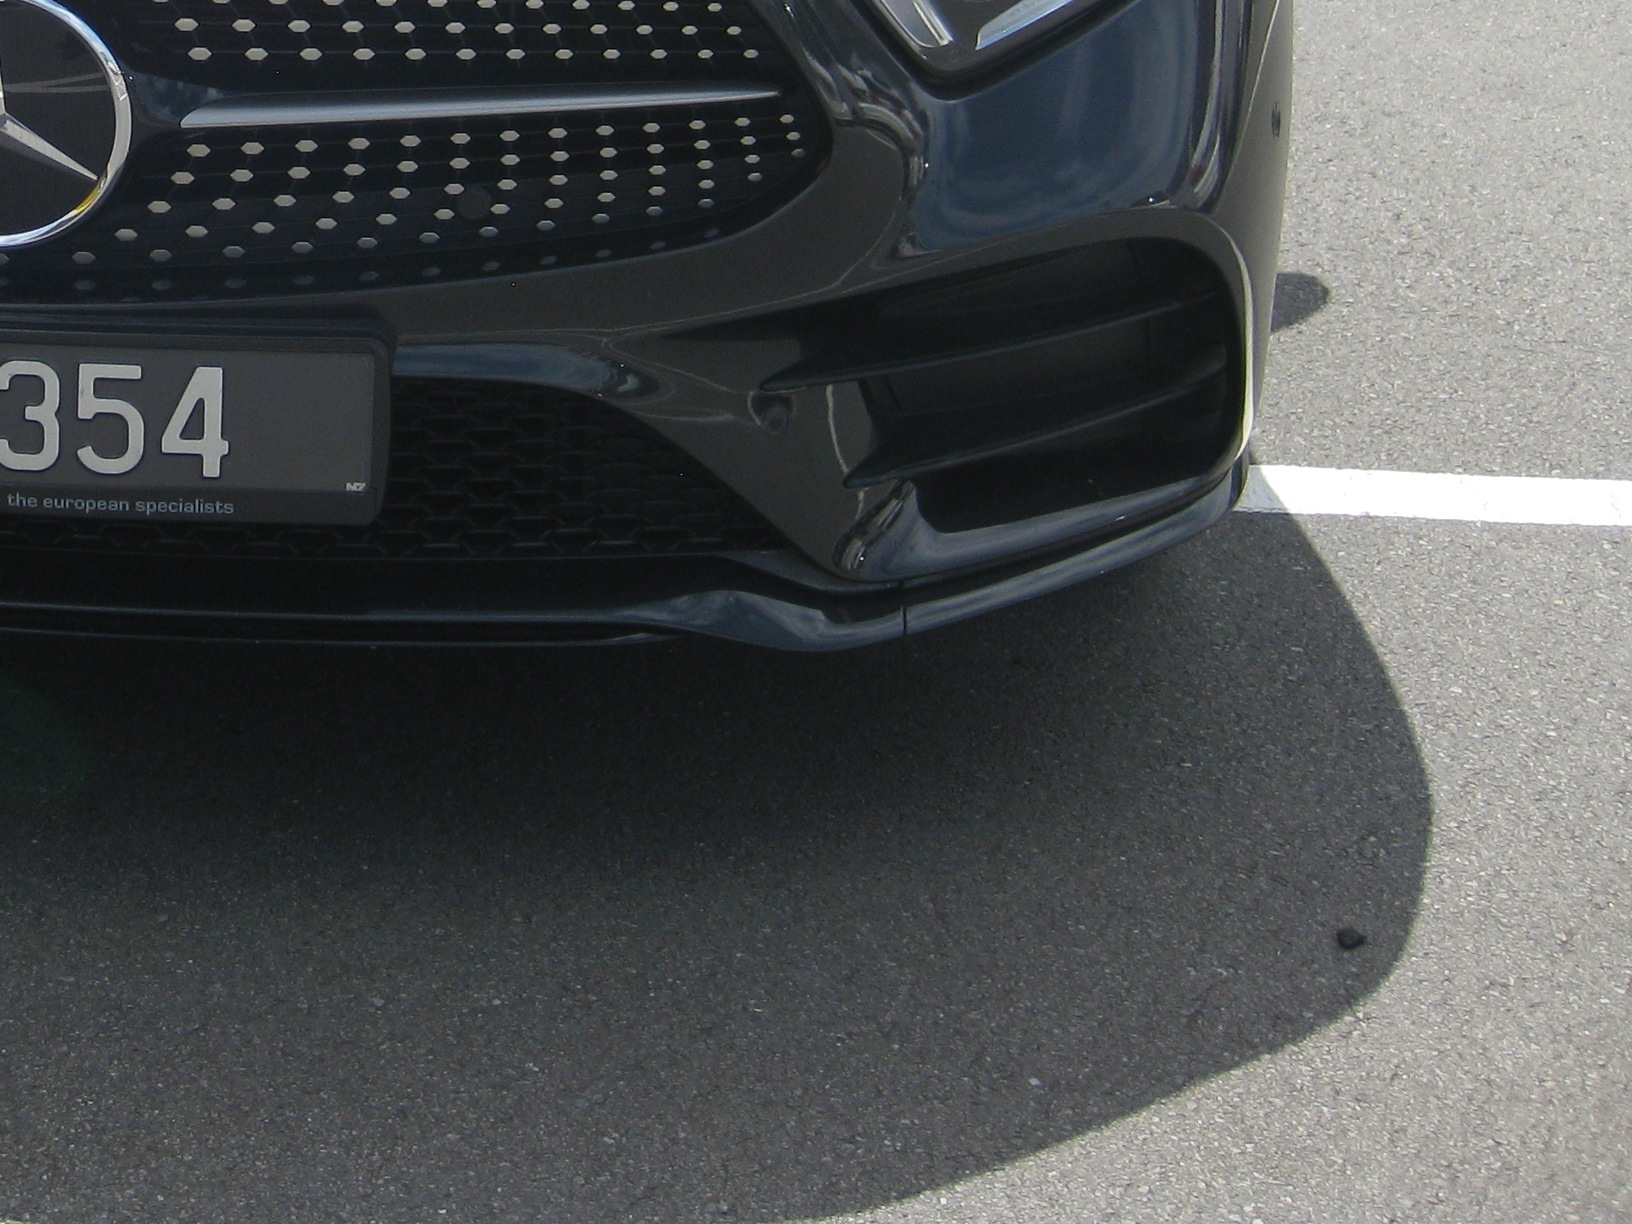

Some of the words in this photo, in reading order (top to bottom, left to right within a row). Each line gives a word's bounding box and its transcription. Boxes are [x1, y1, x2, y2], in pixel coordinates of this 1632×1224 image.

[7, 492, 38, 508] the
[42, 496, 130, 516] european
[135, 497, 235, 516] specialists
